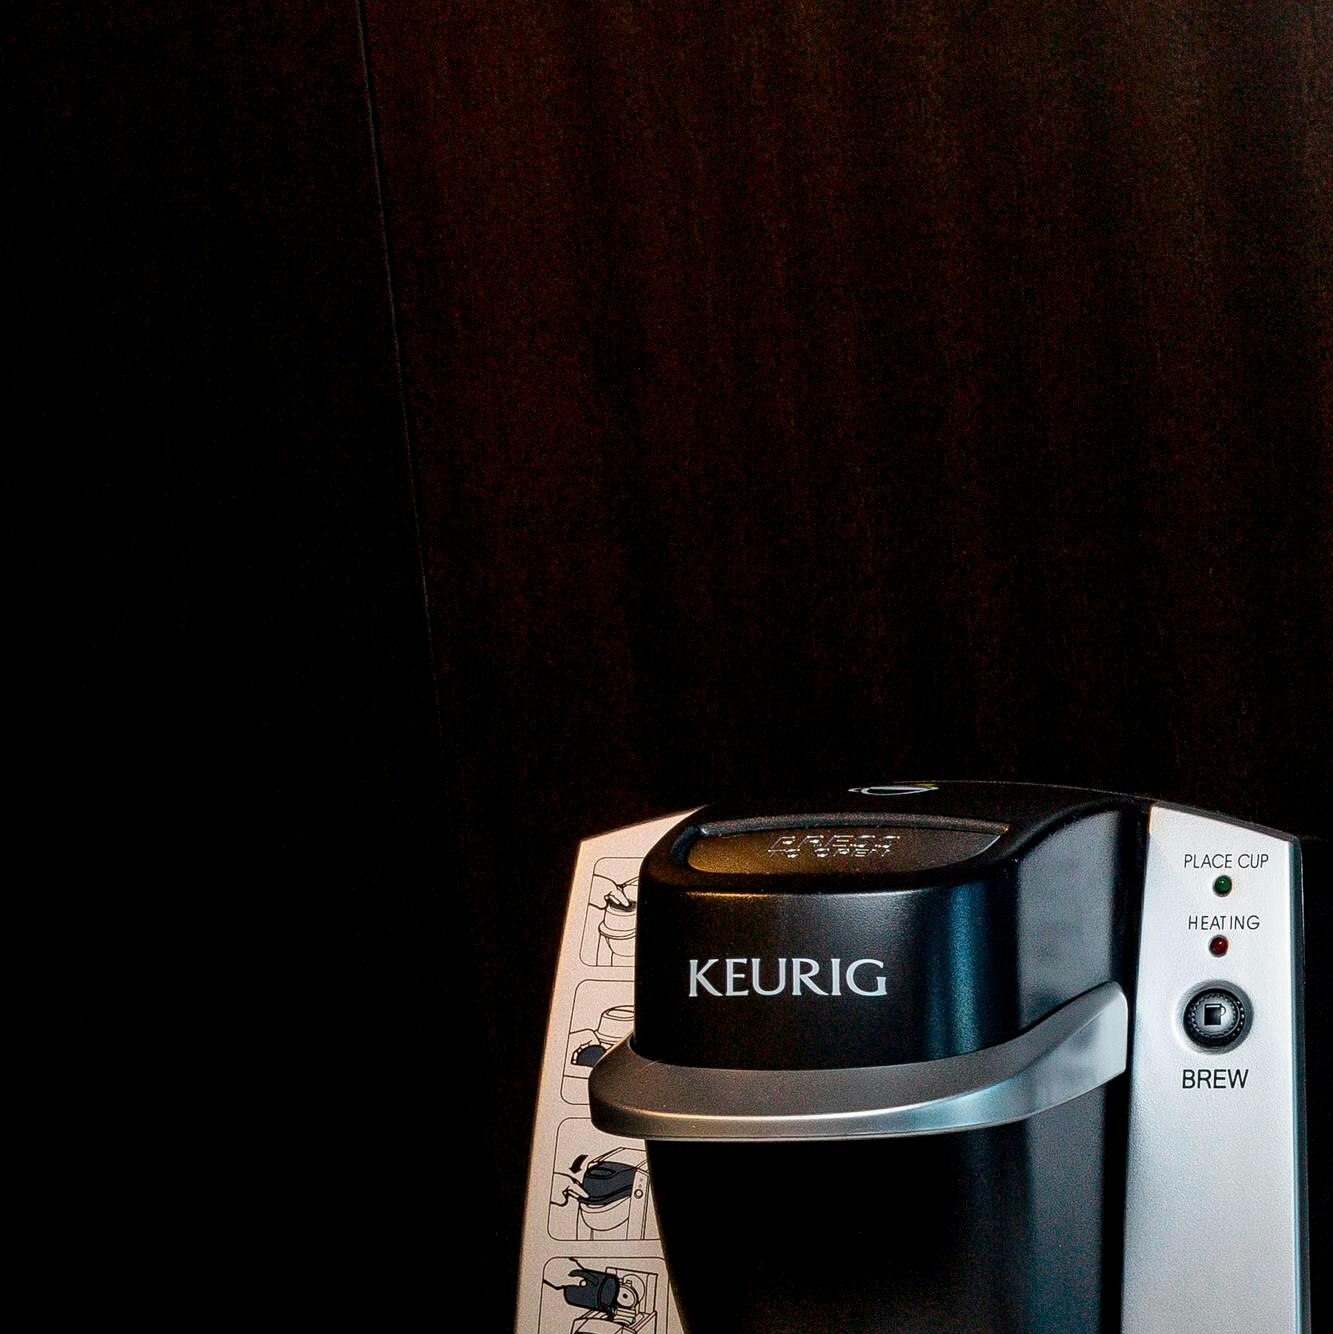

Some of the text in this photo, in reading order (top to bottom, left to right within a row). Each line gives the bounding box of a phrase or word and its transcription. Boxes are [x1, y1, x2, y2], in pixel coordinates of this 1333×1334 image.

[1184, 853, 1270, 870] PLACE CUP
[1187, 915, 1260, 931] HEATING
[687, 957, 888, 998] KEURIG
[1181, 1069, 1248, 1090] BREW
